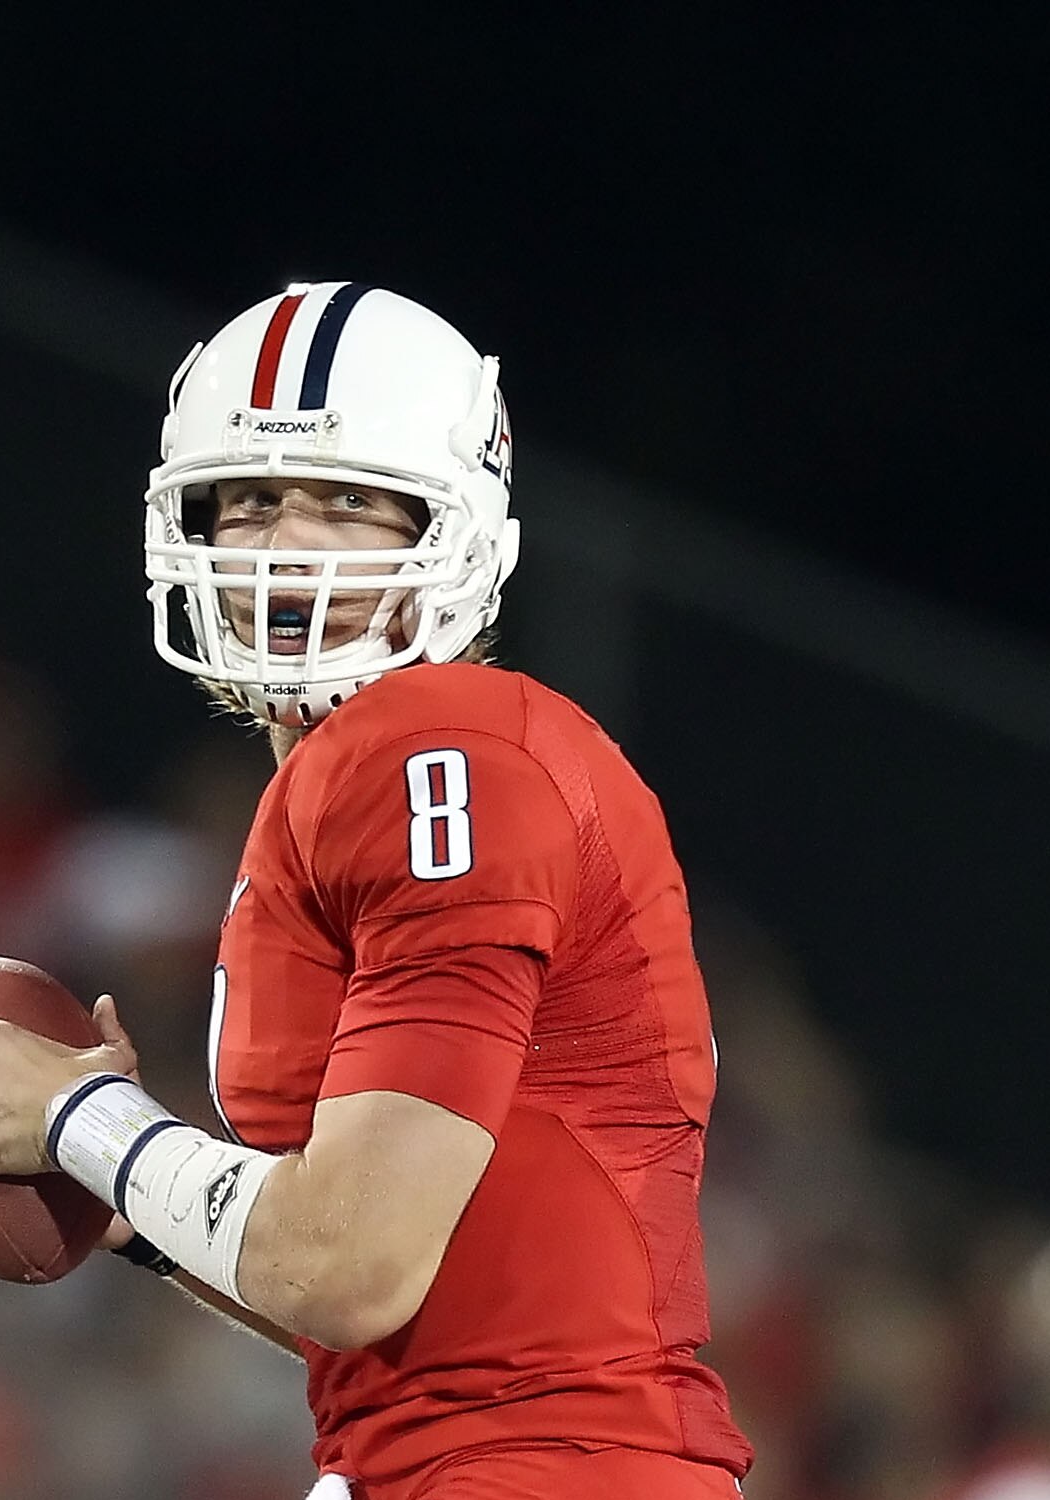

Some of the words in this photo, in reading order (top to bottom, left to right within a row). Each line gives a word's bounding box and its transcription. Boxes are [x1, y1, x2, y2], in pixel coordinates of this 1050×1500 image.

[254, 422, 317, 433] ARIZONA
[263, 684, 306, 695] Riddell
[405, 748, 473, 882] 8
[209, 1170, 237, 1220] PRO
